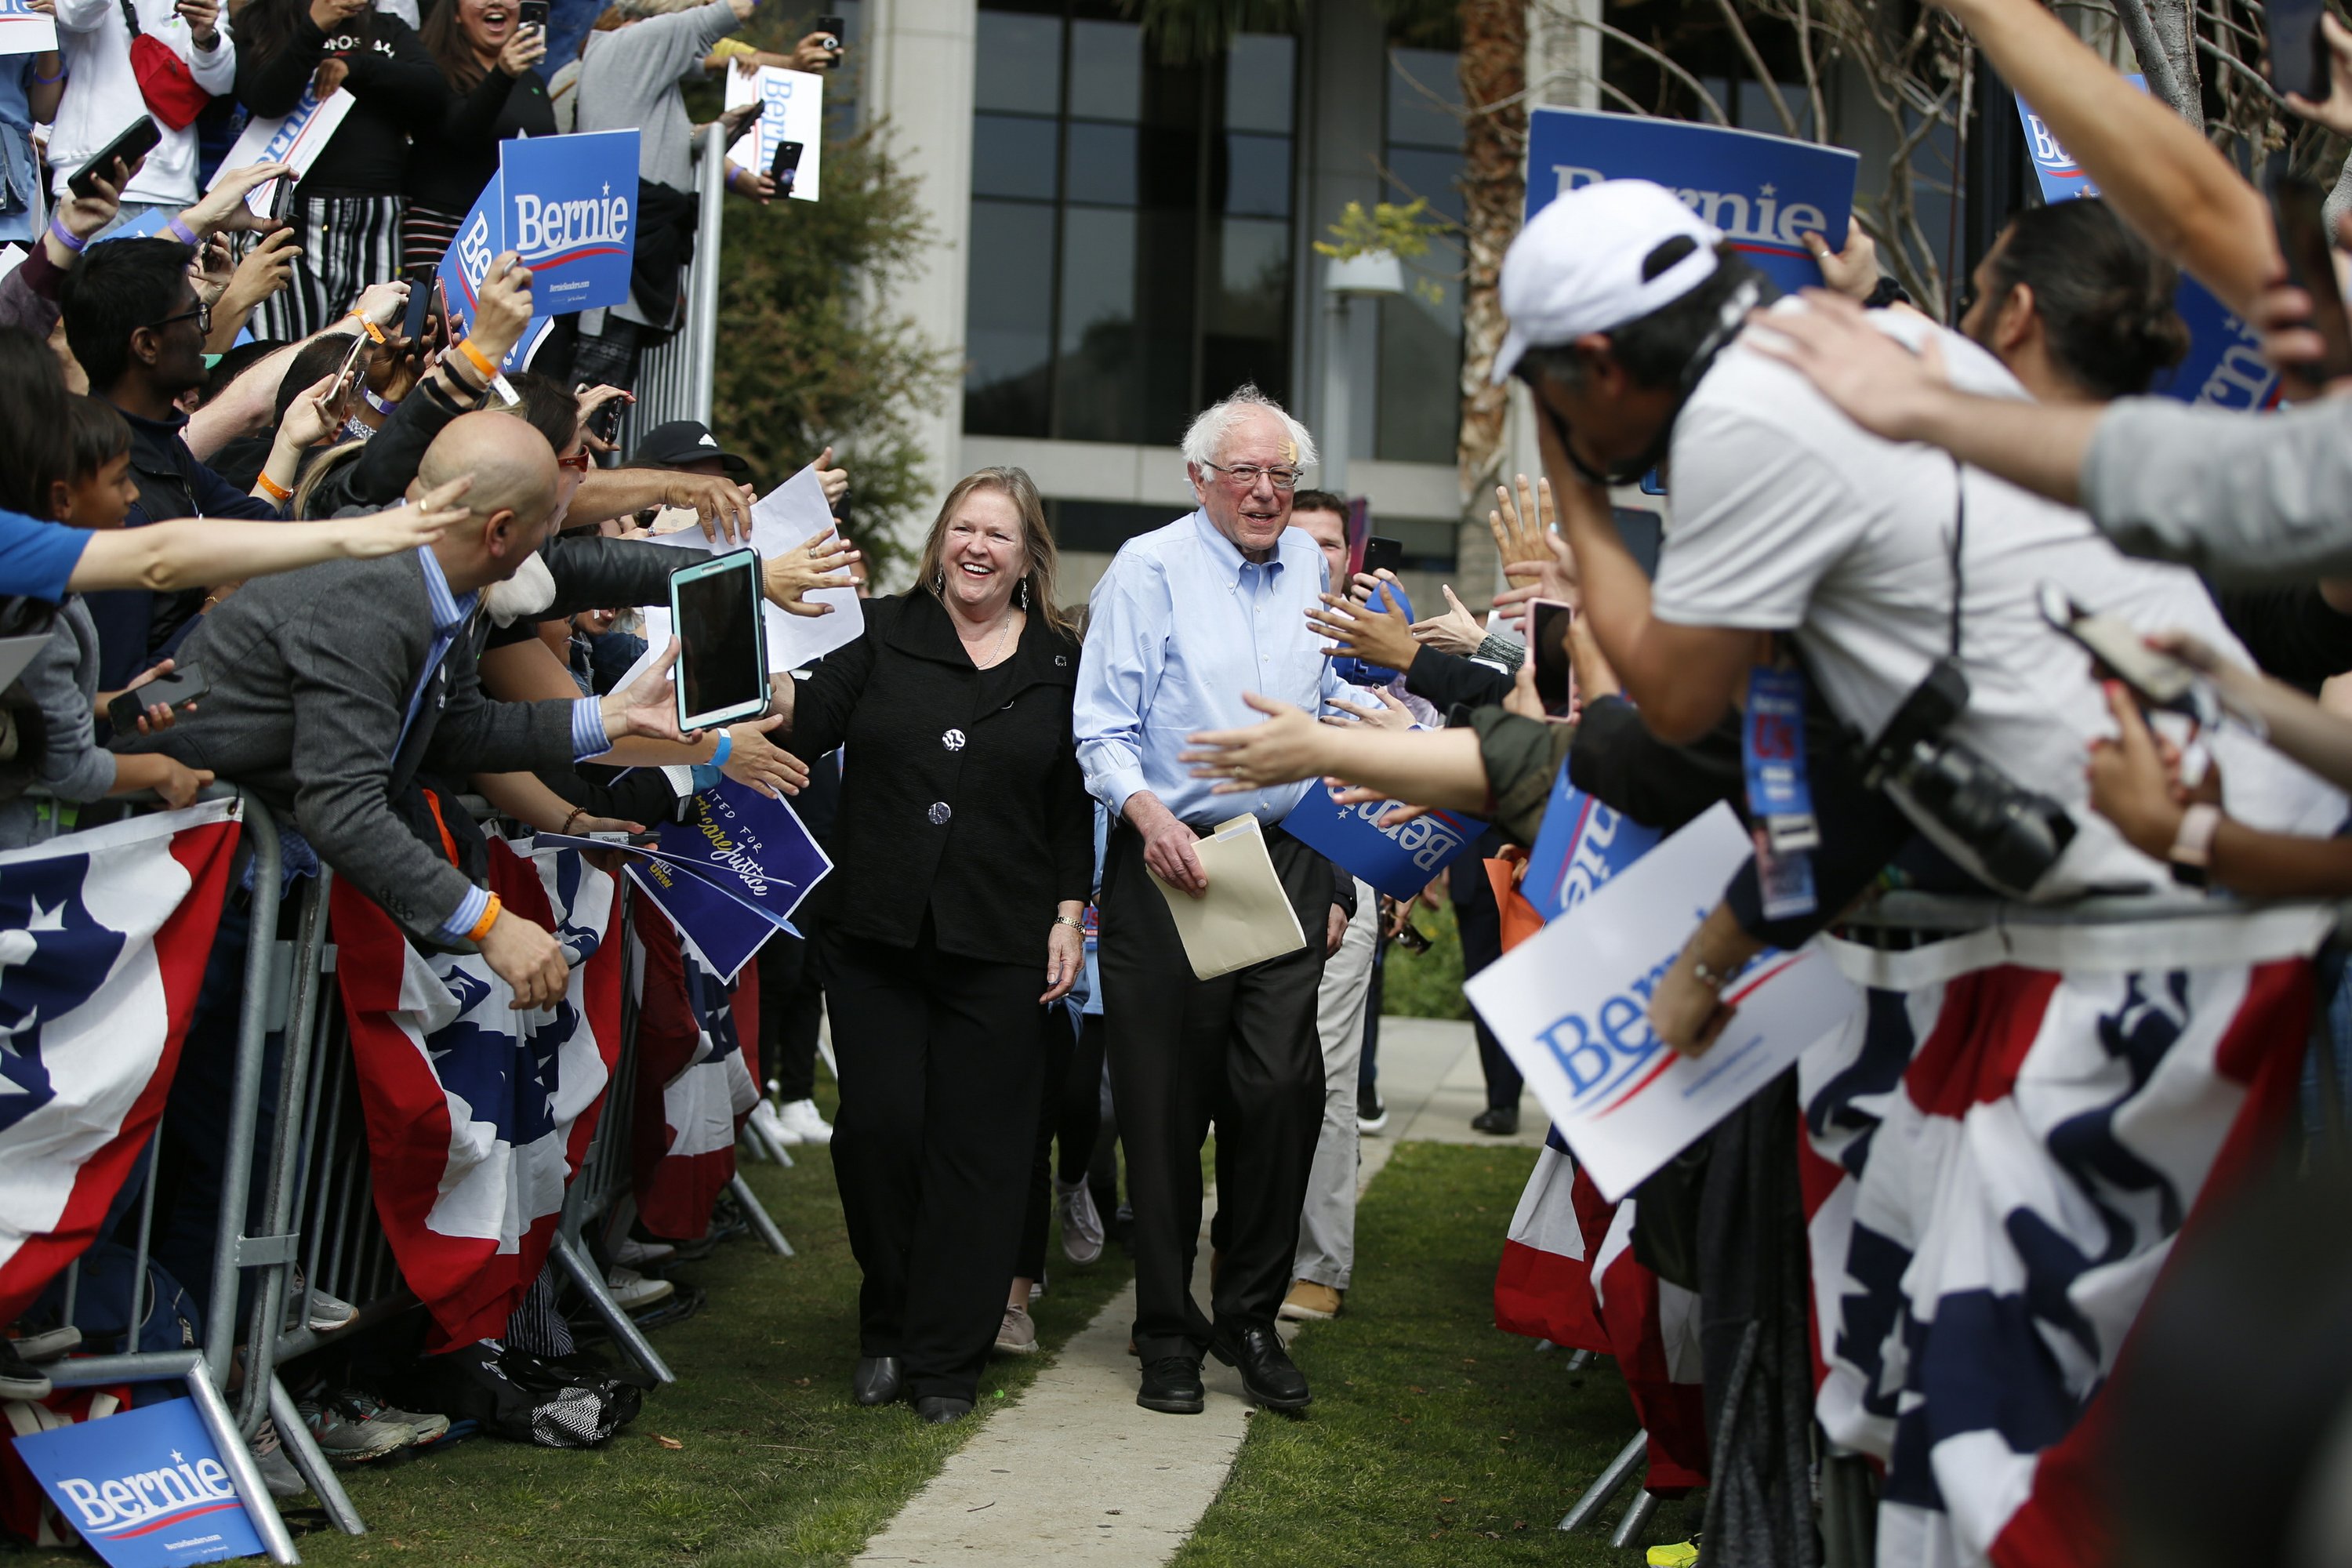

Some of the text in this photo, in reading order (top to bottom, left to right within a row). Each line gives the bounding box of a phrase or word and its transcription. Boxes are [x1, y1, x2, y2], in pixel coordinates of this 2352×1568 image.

[514, 180, 629, 251] Bernie
[707, 789, 762, 854] ITED FOR
[649, 863, 673, 888] UHW
[56, 1449, 234, 1526] Bernie
